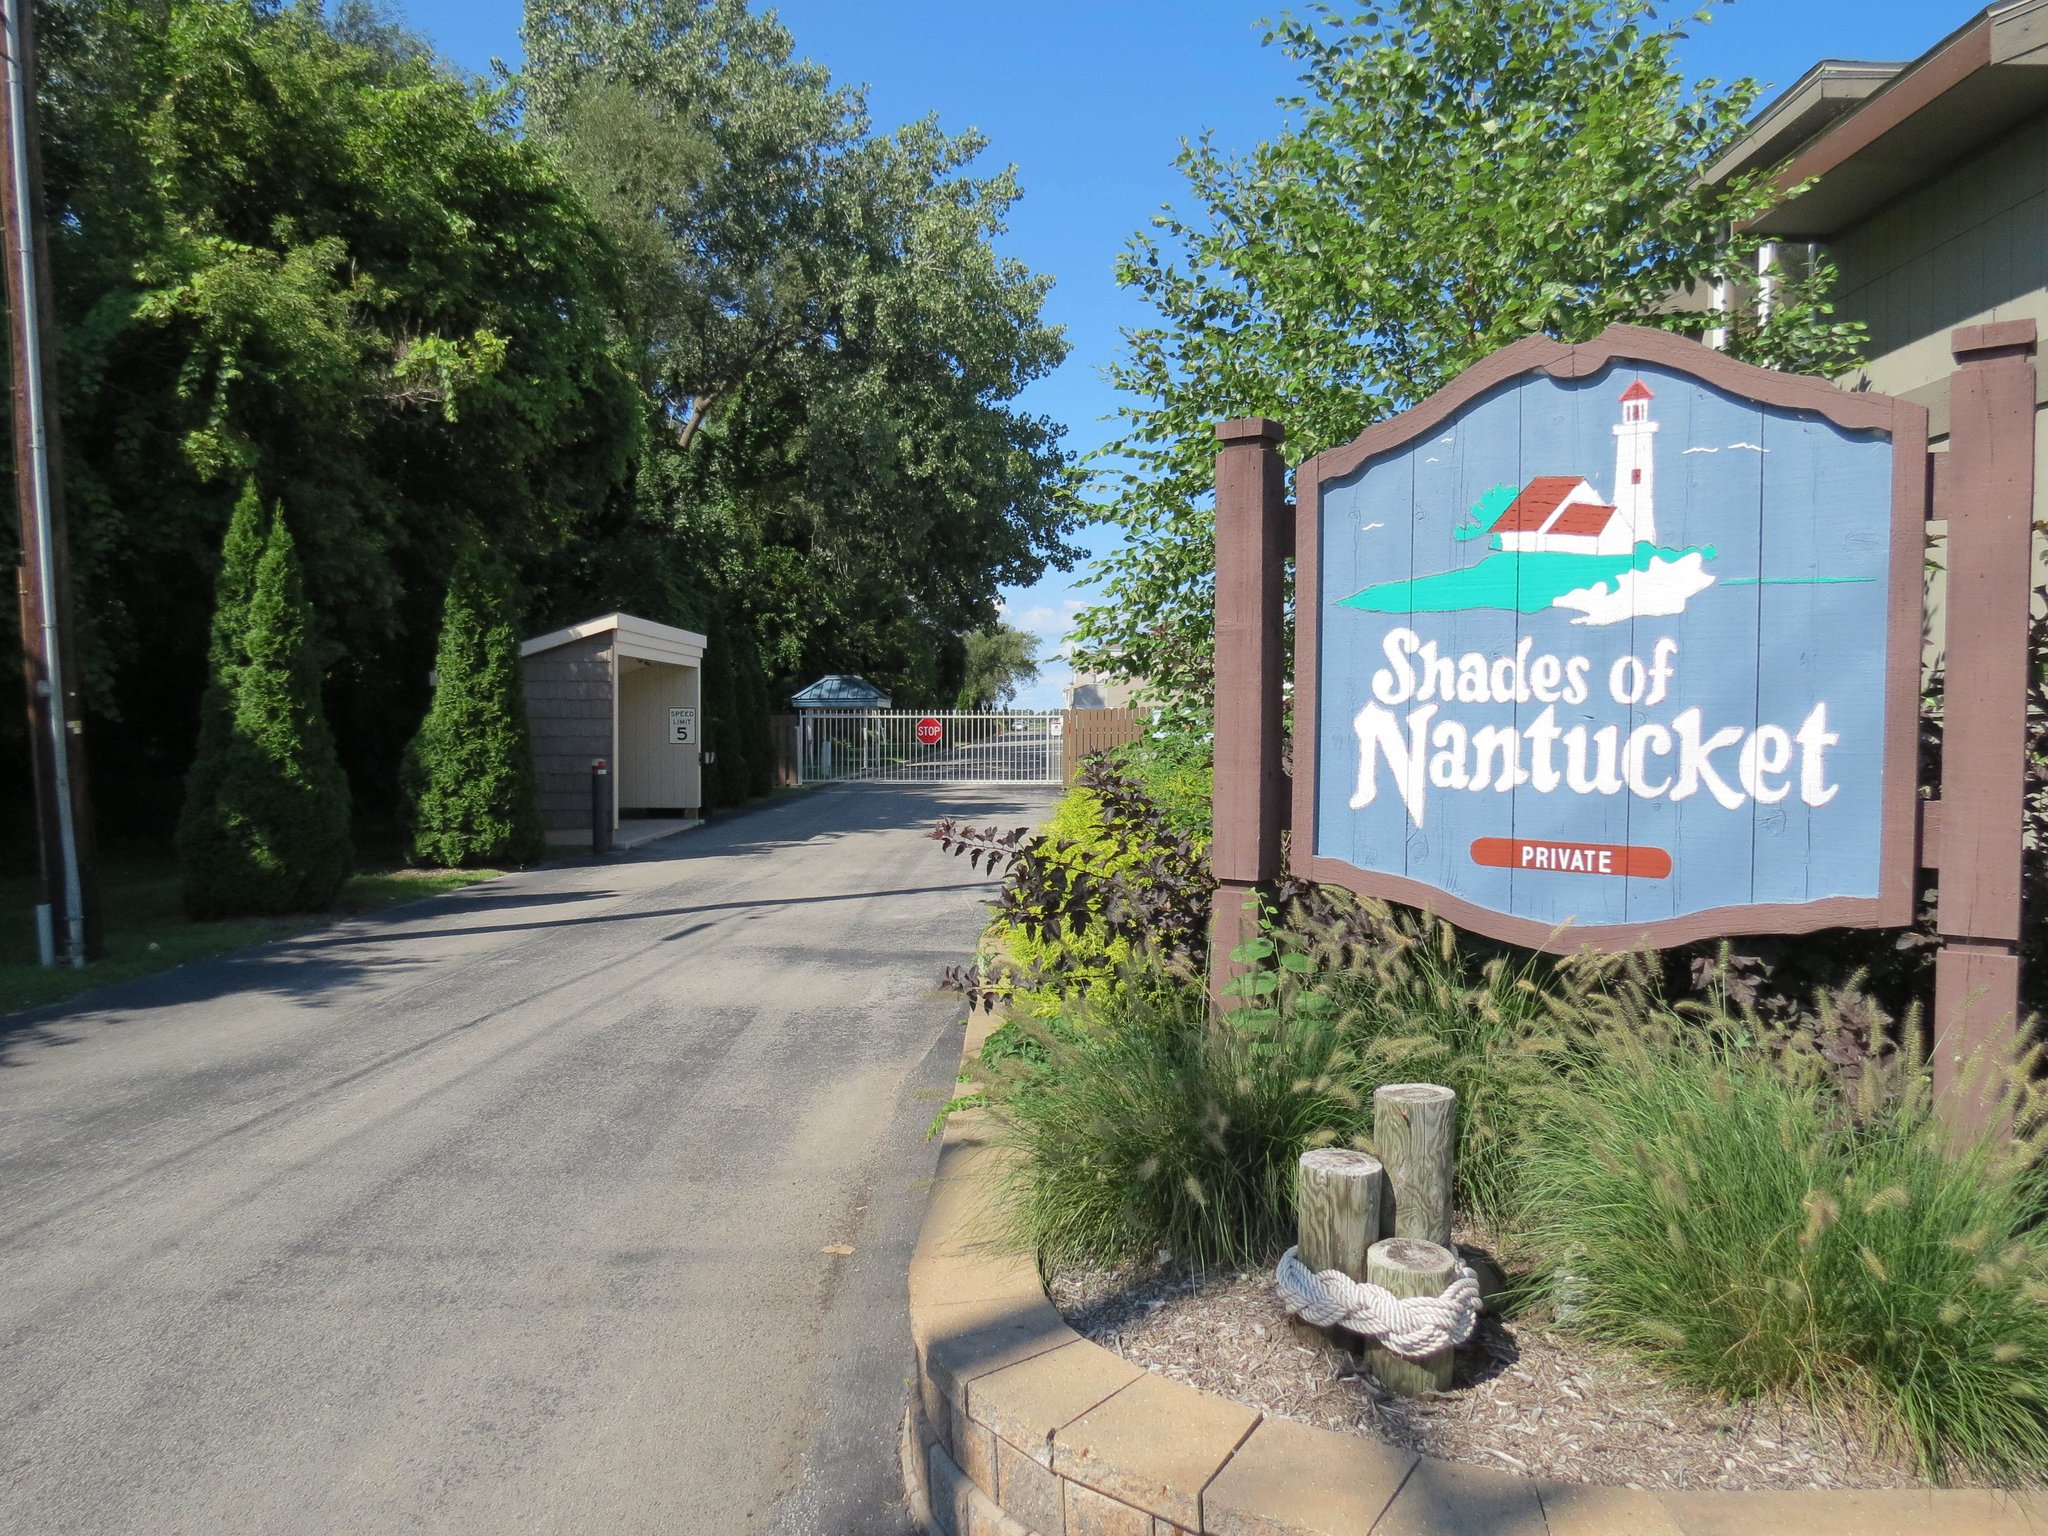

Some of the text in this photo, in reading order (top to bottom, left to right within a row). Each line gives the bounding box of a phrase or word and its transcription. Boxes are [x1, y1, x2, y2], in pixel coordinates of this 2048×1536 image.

[1371, 627, 1677, 706] Shades of
[677, 727, 688, 741] 5
[918, 726, 940, 736] STOP
[1349, 700, 1840, 829] Nantucket
[1521, 846, 1613, 874] PRIVATE
